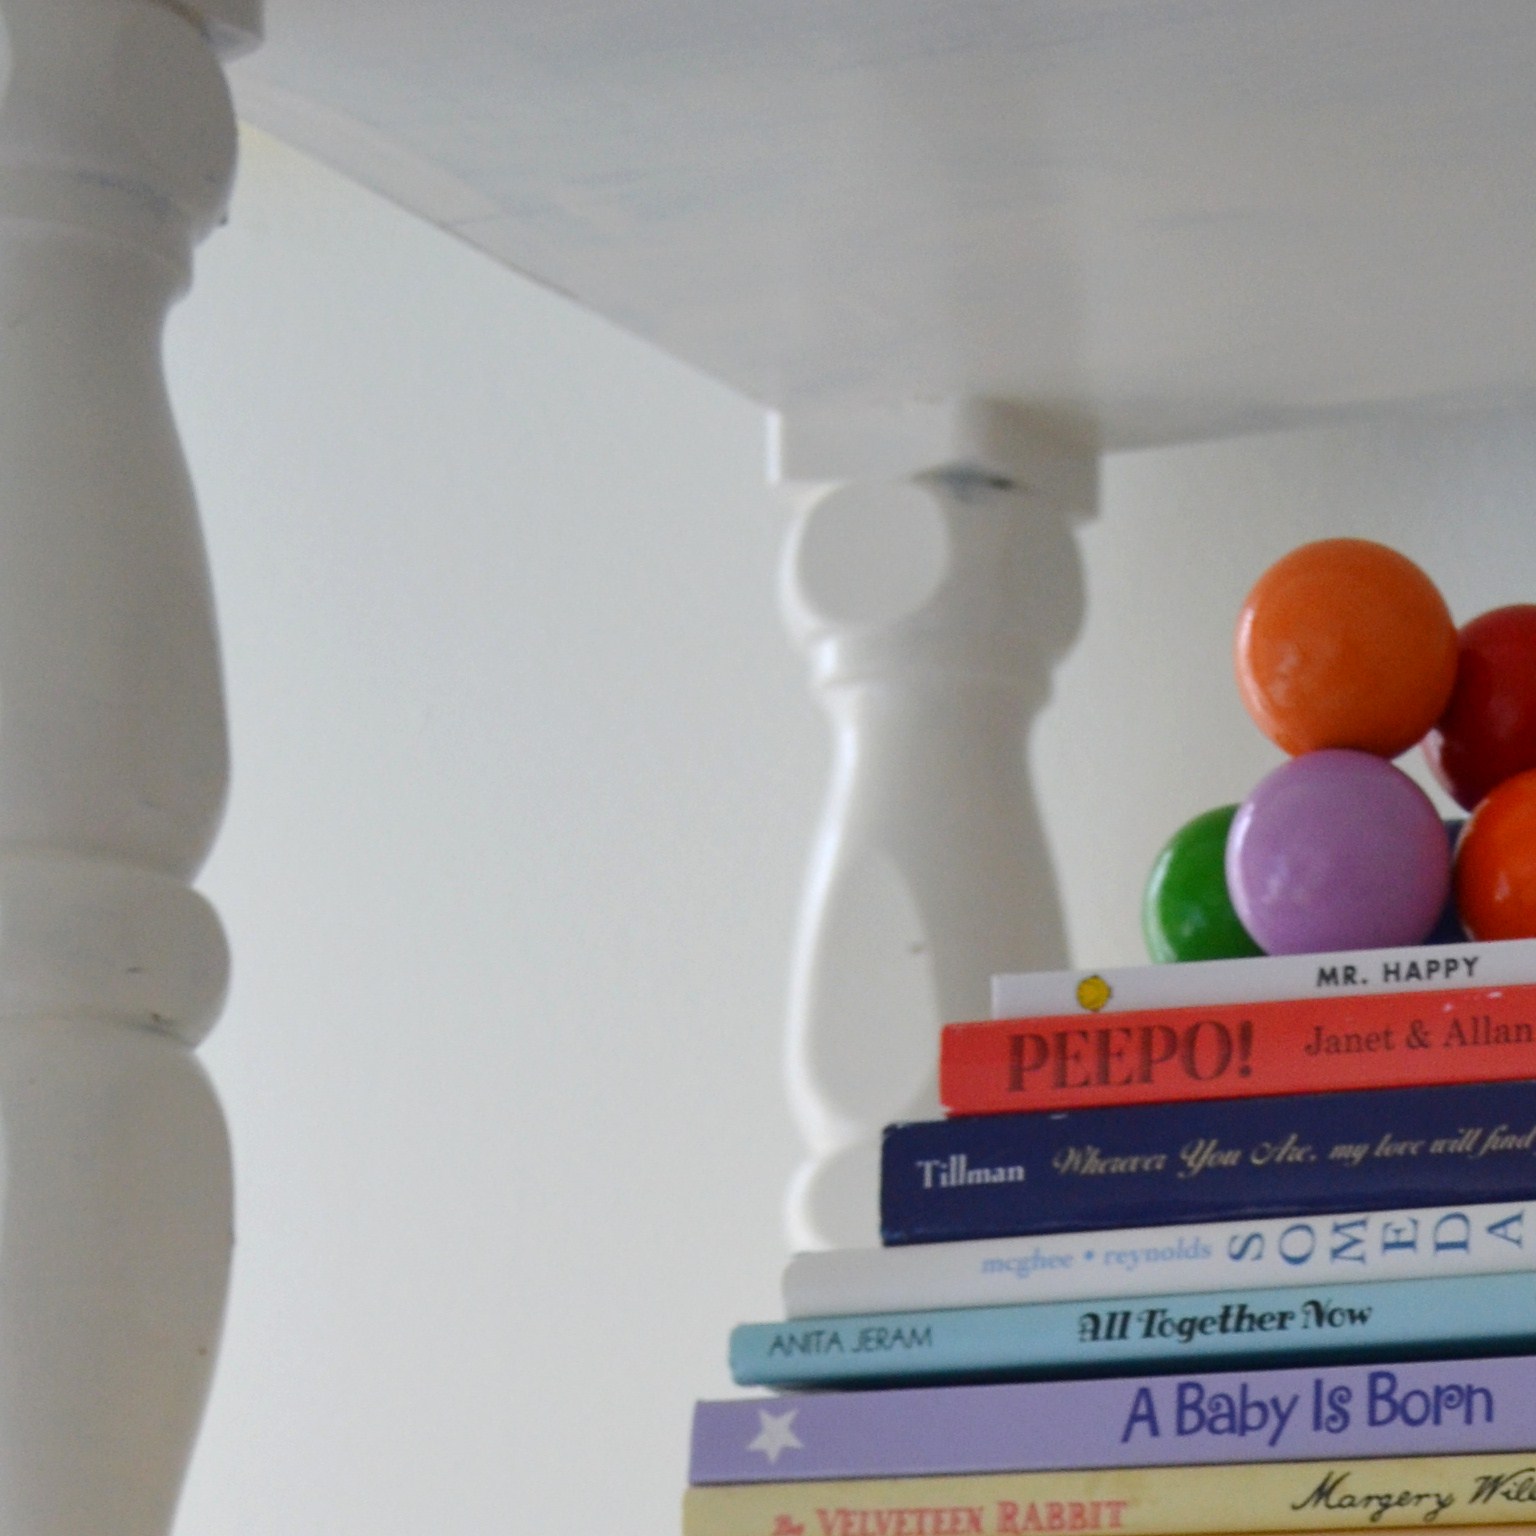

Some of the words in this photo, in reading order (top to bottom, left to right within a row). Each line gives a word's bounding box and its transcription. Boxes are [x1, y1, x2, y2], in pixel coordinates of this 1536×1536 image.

[1316, 965, 1368, 988] MR.
[1383, 957, 1481, 983] HAPPY
[1007, 1020, 1254, 1093] PEEPO!
[1304, 1023, 1394, 1058] Janet
[1405, 1019, 1431, 1050] &
[1441, 1016, 1533, 1047] Allan
[916, 1154, 1025, 1189] Tillman
[1177, 1138, 1242, 1179] You
[1328, 1143, 1367, 1167] my
[1374, 1133, 1426, 1158] love
[1430, 1128, 1475, 1154] will
[1472, 1124, 1533, 1158] find
[981, 1248, 1074, 1279] mcghee
[1103, 1238, 1212, 1271] reynolds
[768, 1330, 842, 1357] ANITA
[851, 1327, 934, 1354] JERAM
[1079, 1310, 1131, 1342] All
[1137, 1304, 1296, 1343] Together
[1300, 1299, 1373, 1330] Now
[1121, 1387, 1160, 1444] A
[1175, 1380, 1300, 1448] Baby
[1311, 1378, 1353, 1434] Is
[1367, 1370, 1495, 1428] Born
[1292, 1470, 1455, 1523] Margery
[997, 1500, 1131, 1536] RABBIT
